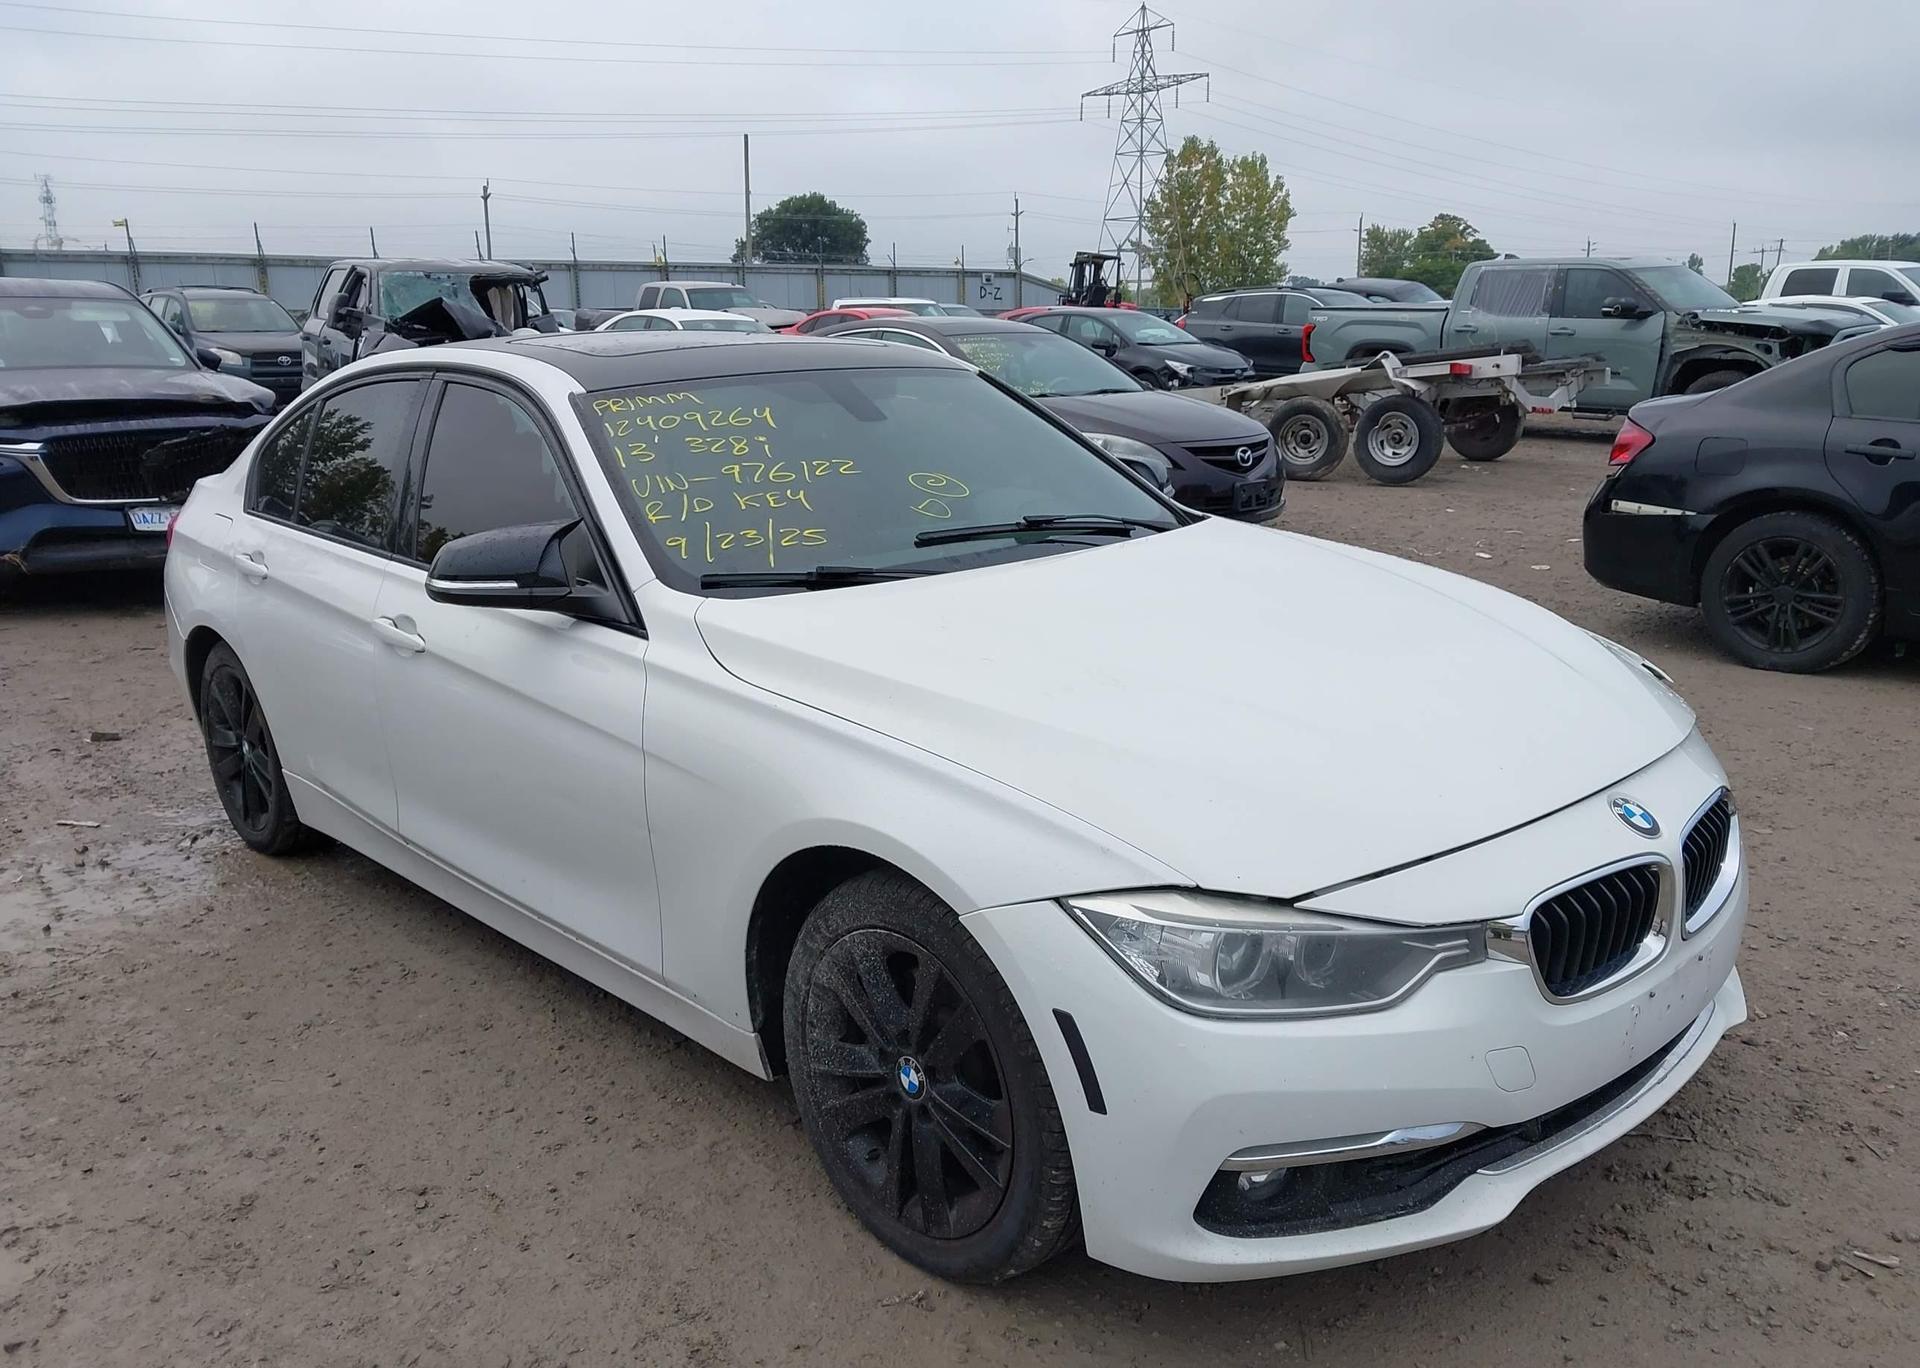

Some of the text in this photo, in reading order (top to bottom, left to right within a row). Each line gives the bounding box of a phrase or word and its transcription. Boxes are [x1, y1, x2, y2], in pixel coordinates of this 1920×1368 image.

[980, 286, 1003, 300] D-Z
[592, 392, 704, 416] PRIMM
[604, 406, 777, 437] 12409264
[684, 435, 772, 458] 328i
[734, 489, 813, 511] KEY
